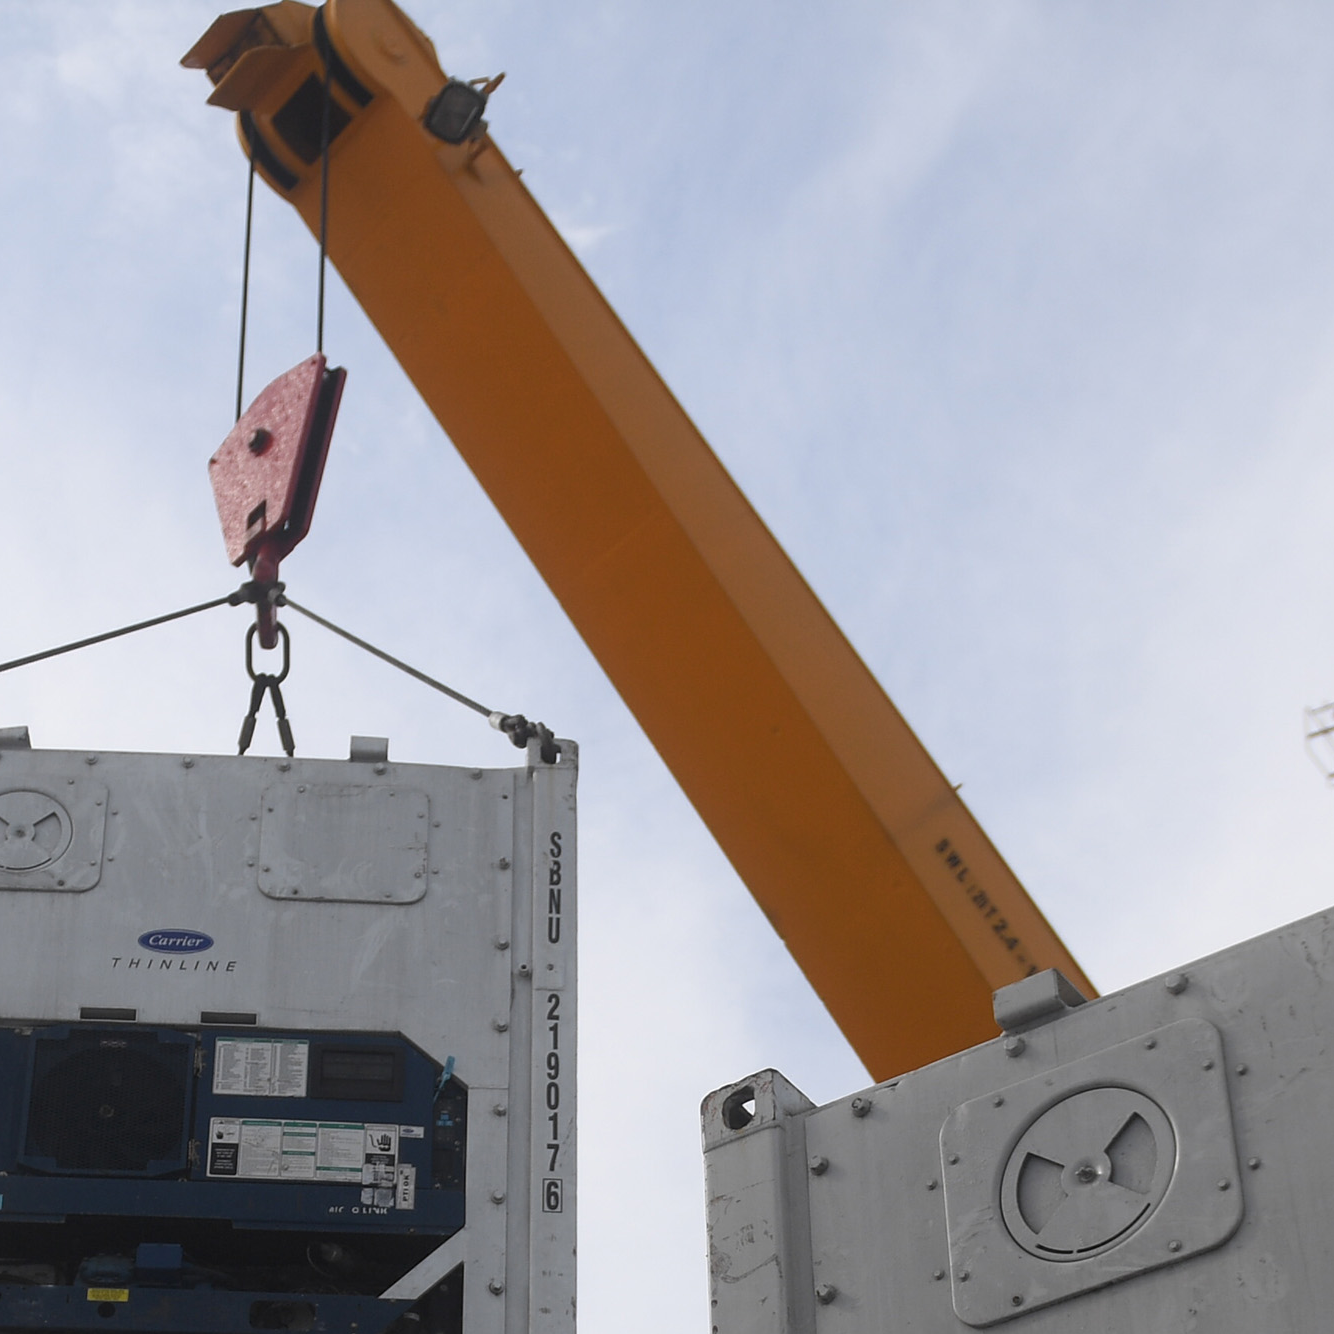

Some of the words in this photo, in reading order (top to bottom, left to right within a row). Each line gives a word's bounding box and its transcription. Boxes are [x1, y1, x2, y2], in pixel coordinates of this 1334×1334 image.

[548, 831, 562, 945] SBNU
[148, 934, 204, 947] Carrier
[111, 957, 237, 972] THINLINE
